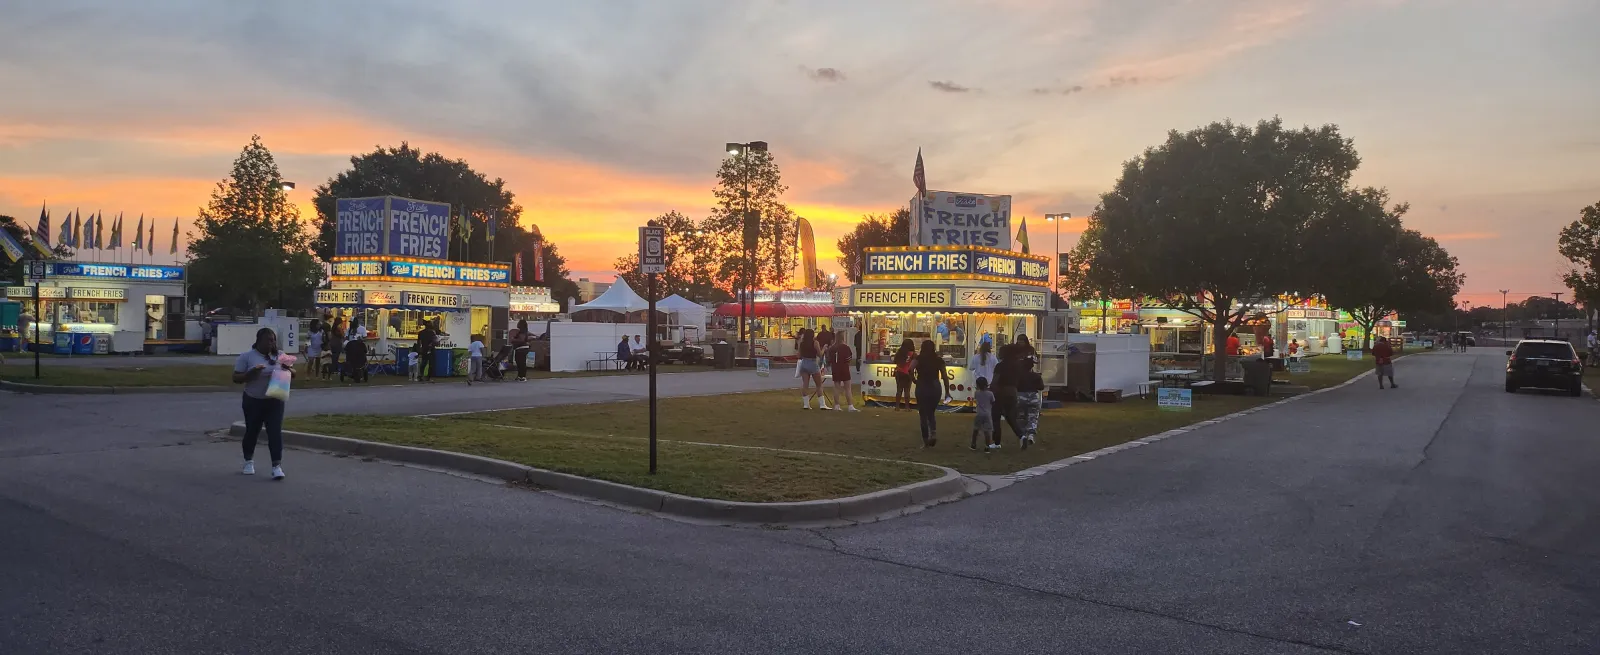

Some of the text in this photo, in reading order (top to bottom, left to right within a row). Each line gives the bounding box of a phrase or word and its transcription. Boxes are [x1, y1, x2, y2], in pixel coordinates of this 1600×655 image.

[349, 200, 367, 212] Fiske
[407, 202, 428, 212] Fiske
[338, 210, 384, 232] FRENCH
[390, 210, 448, 236] FRENCH
[924, 207, 1006, 228] FRENCH
[345, 232, 378, 254] FRIES
[932, 229, 998, 246] FRIES
[401, 234, 441, 258] FRIES
[333, 262, 382, 275] FRENCH FRIES
[870, 254, 968, 271] FRENCH FRIES
[988, 257, 1016, 274] FRENCH
[1022, 261, 1040, 278] FRIES
[83, 265, 126, 276] FRENCH
[132, 268, 163, 278] FRIES
[392, 265, 506, 280] Fiske FRENCH FRIES Fiske
[104, 290, 123, 298] FRIES
[317, 292, 358, 302] FRENCH FRIES
[407, 294, 434, 304] FRENCH
[438, 296, 457, 306] FRIES
[860, 292, 944, 303] FRENCH FRIES
[961, 292, 1002, 300] Fiske
[1013, 294, 1043, 306] FRENCH FRIES
